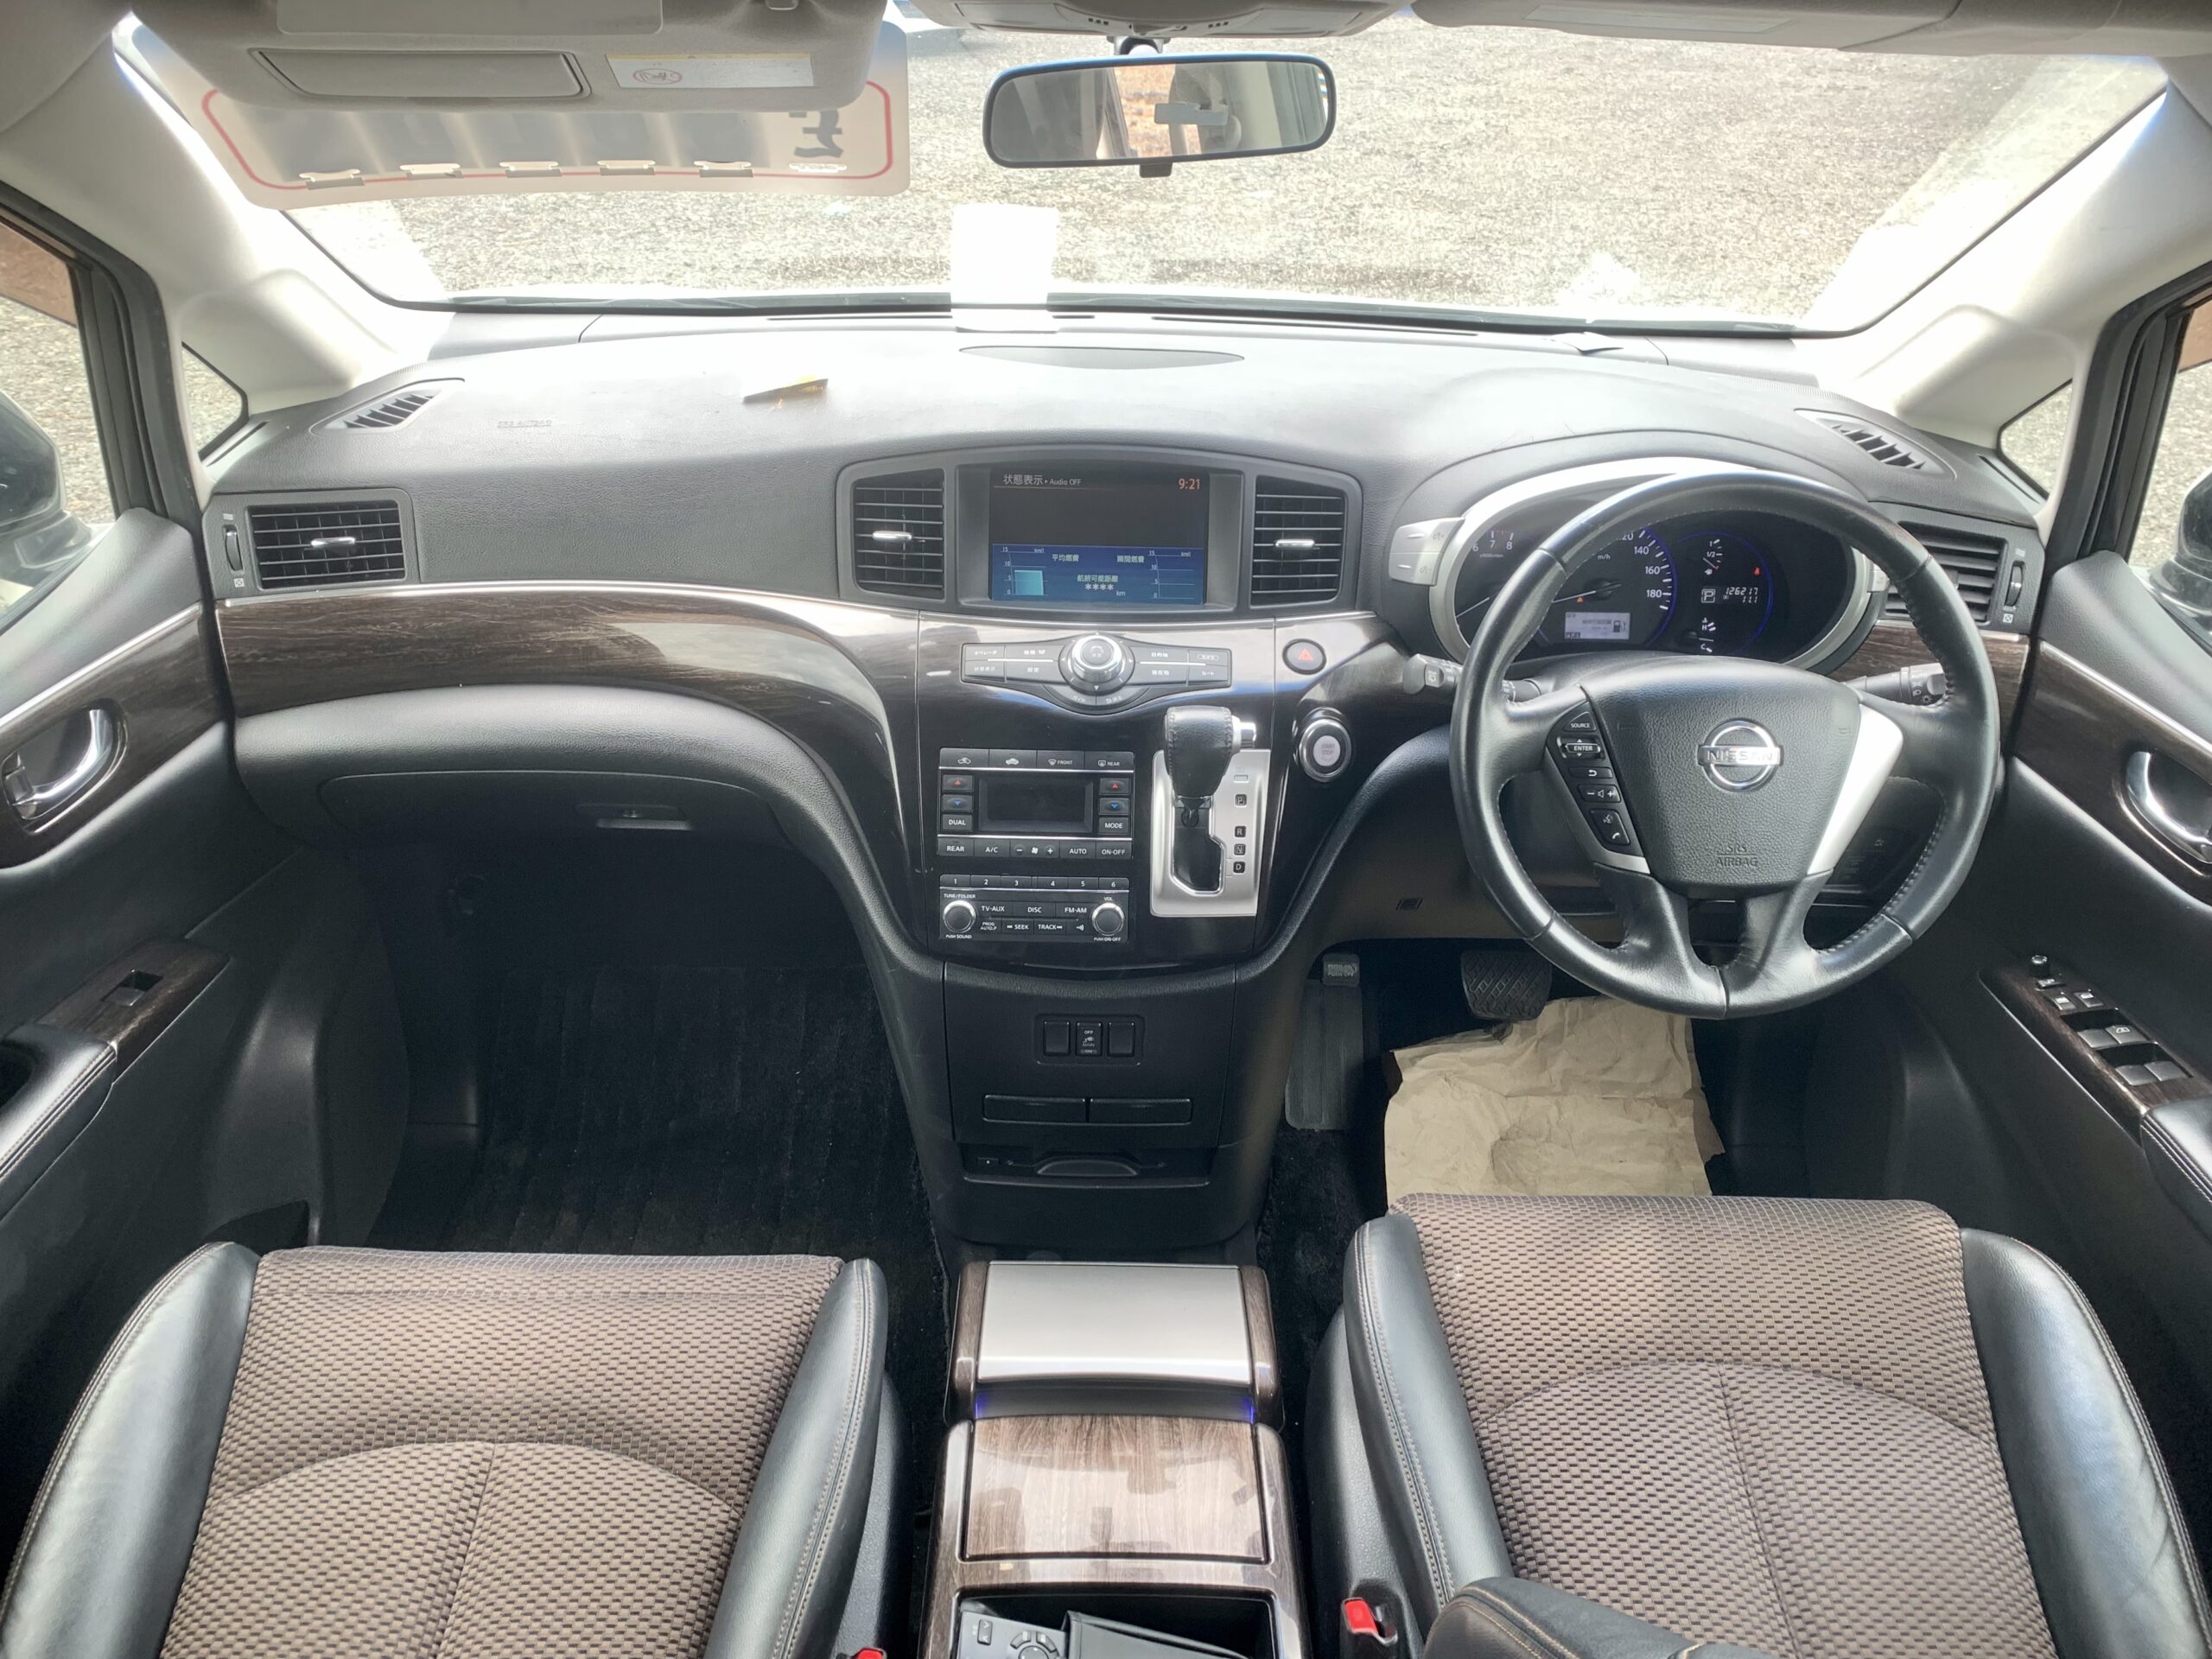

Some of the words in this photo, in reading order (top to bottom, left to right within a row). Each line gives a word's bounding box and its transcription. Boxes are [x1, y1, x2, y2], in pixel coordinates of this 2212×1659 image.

[1003, 474, 1043, 485] 状態表示
[1179, 478, 1200, 490] 9:21
[1490, 539, 1496, 549] 7
[1506, 541, 1512, 550] 8
[1634, 546, 1649, 555] 140
[1645, 566, 1661, 575] 160
[1646, 589, 1662, 598] 180
[1726, 587, 1758, 595] 126217
[1707, 750, 1773, 761] NISSAN
[1716, 856, 1758, 867] AIRBAG
